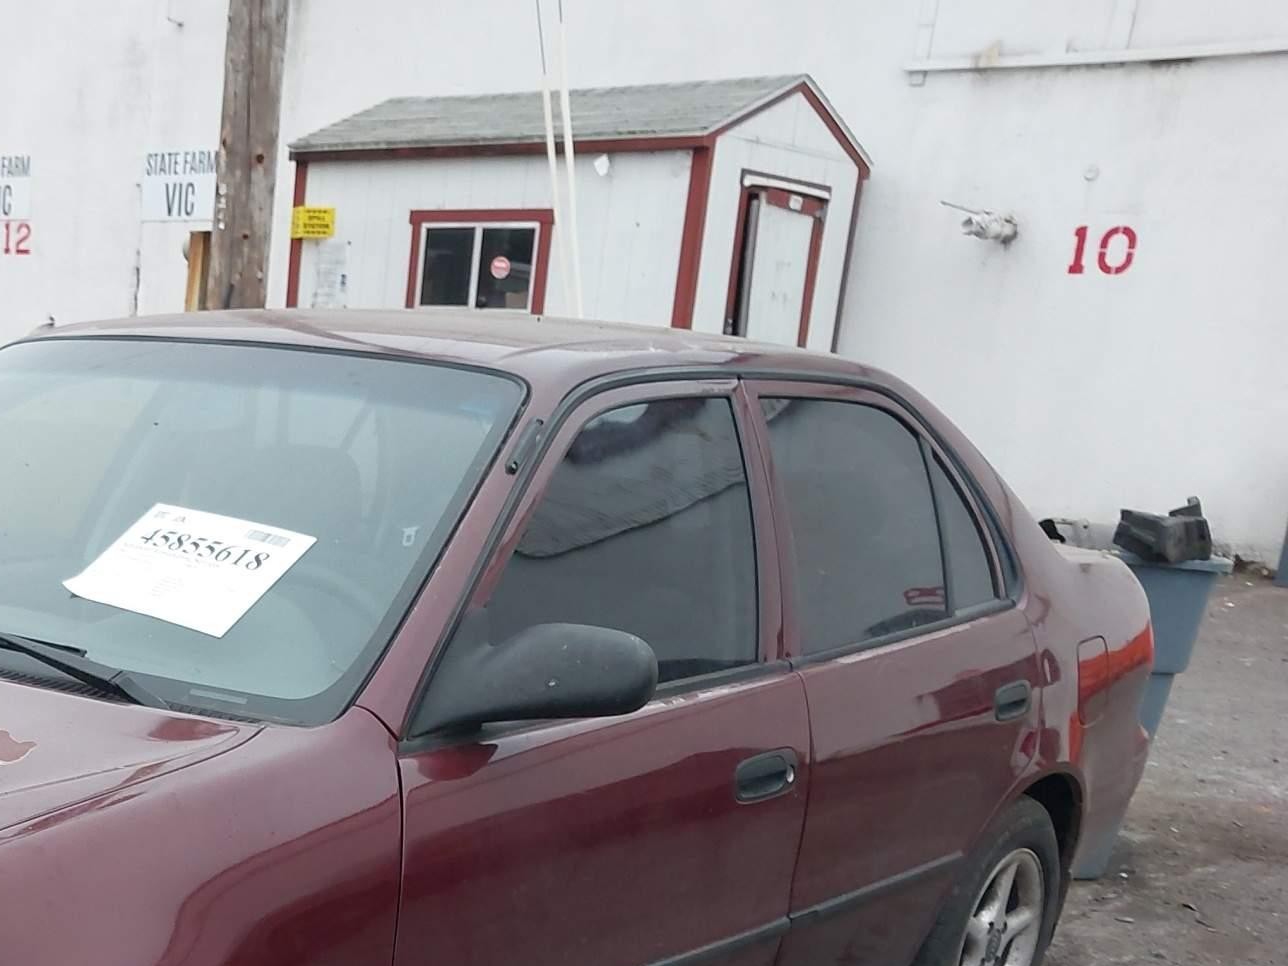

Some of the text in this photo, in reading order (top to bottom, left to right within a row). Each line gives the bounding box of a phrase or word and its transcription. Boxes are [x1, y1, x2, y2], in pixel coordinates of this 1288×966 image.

[1, 156, 30, 177] FARM
[146, 150, 219, 176] STATE FARM
[165, 182, 195, 216] VIC
[3, 222, 32, 254] 12
[1067, 225, 1138, 275] 10
[141, 528, 271, 571] 45855618
